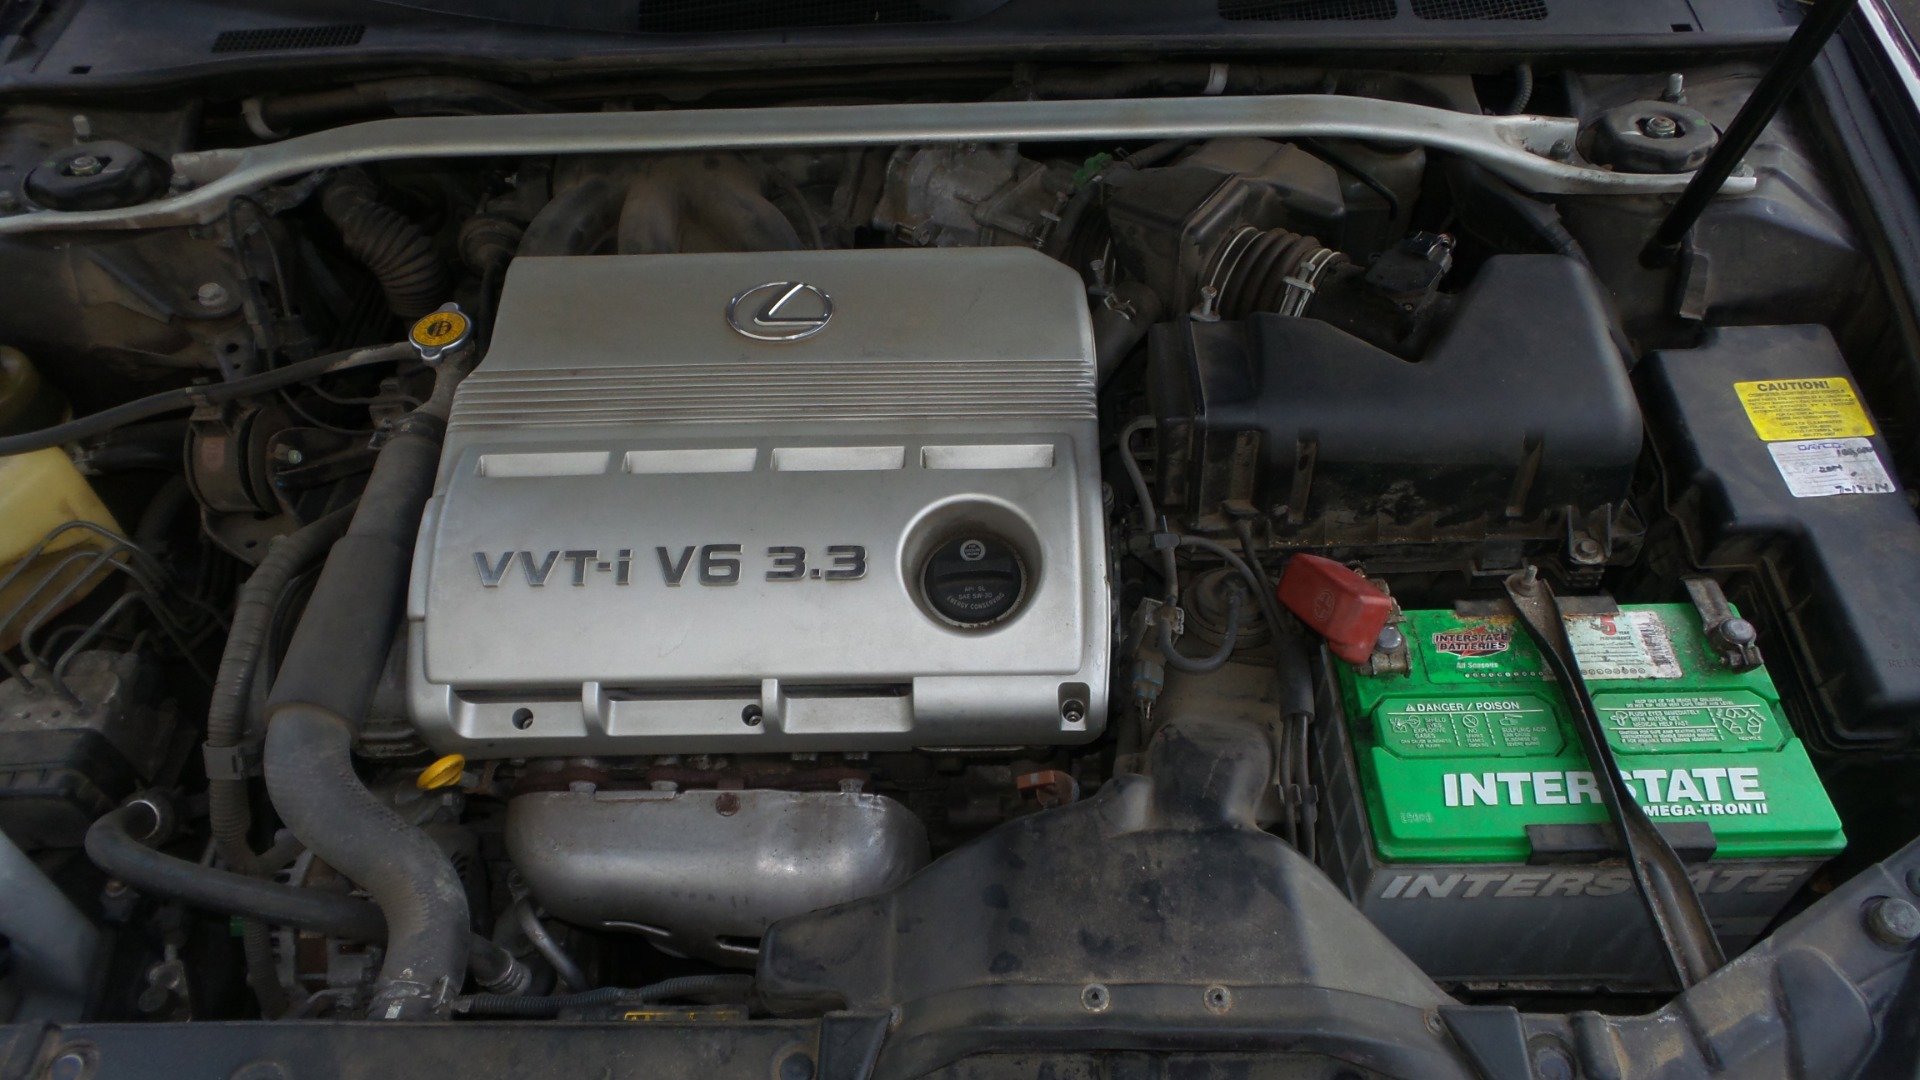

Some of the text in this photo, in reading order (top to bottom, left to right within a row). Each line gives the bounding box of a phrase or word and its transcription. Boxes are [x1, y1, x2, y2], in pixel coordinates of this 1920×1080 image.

[1757, 381, 1830, 391] CAUTION!
[474, 543, 868, 587] VVT-i V6 3.3
[1600, 615, 1617, 636] 5
[1436, 633, 1508, 642] INTERSTATE
[1440, 642, 1506, 650] BATTERIES
[1417, 703, 1464, 711] DANGER
[1476, 702, 1520, 710] POISON
[1643, 805, 1754, 817] MEGA-TRON
[1380, 868, 1807, 899] INTERSTE
